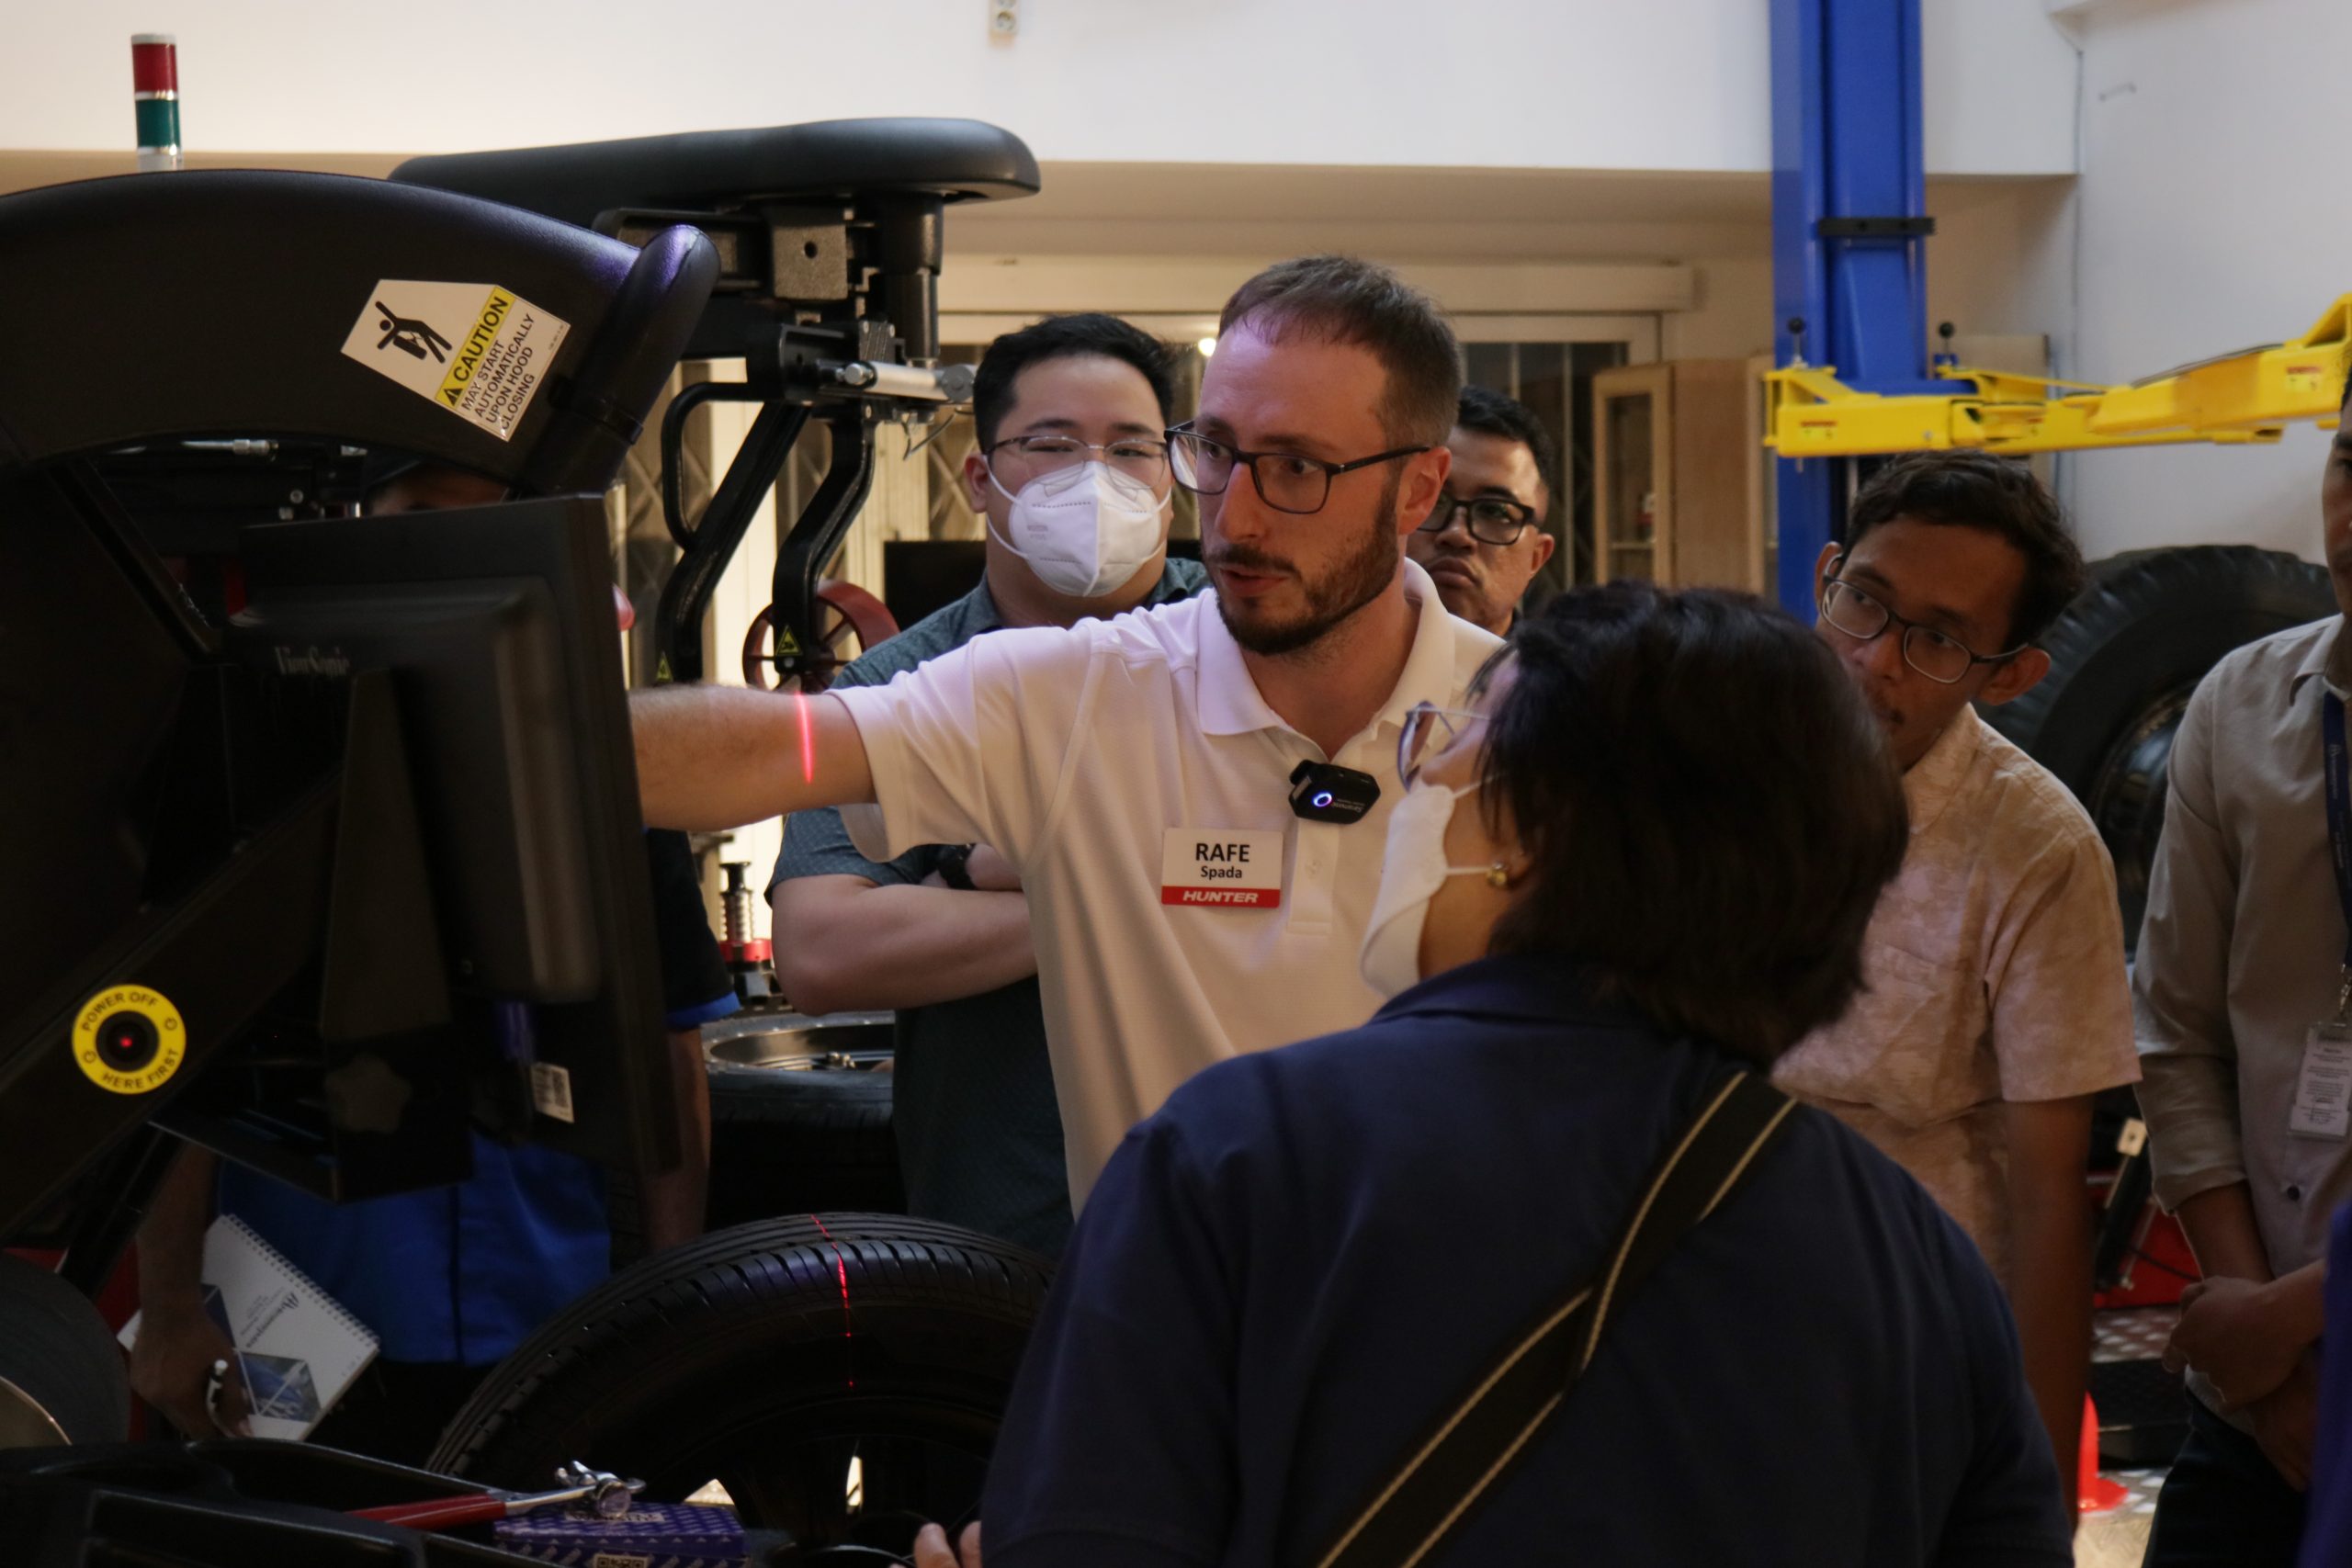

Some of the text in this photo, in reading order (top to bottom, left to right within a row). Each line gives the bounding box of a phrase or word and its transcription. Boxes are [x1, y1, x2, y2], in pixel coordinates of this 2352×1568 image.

[453, 296, 509, 382] CAUTION
[461, 340, 505, 411] MAY START
[474, 313, 535, 418] AUTOMATICALLY
[486, 346, 533, 423] UPON HOOD
[502, 374, 535, 430] CLOSING
[1195, 842, 1250, 863] RAFE
[1200, 865, 1243, 880] Spada
[1182, 890, 1259, 904] HUNTER
[82, 991, 160, 1032] POWER OFF
[102, 1047, 180, 1089] HERE FIRST
